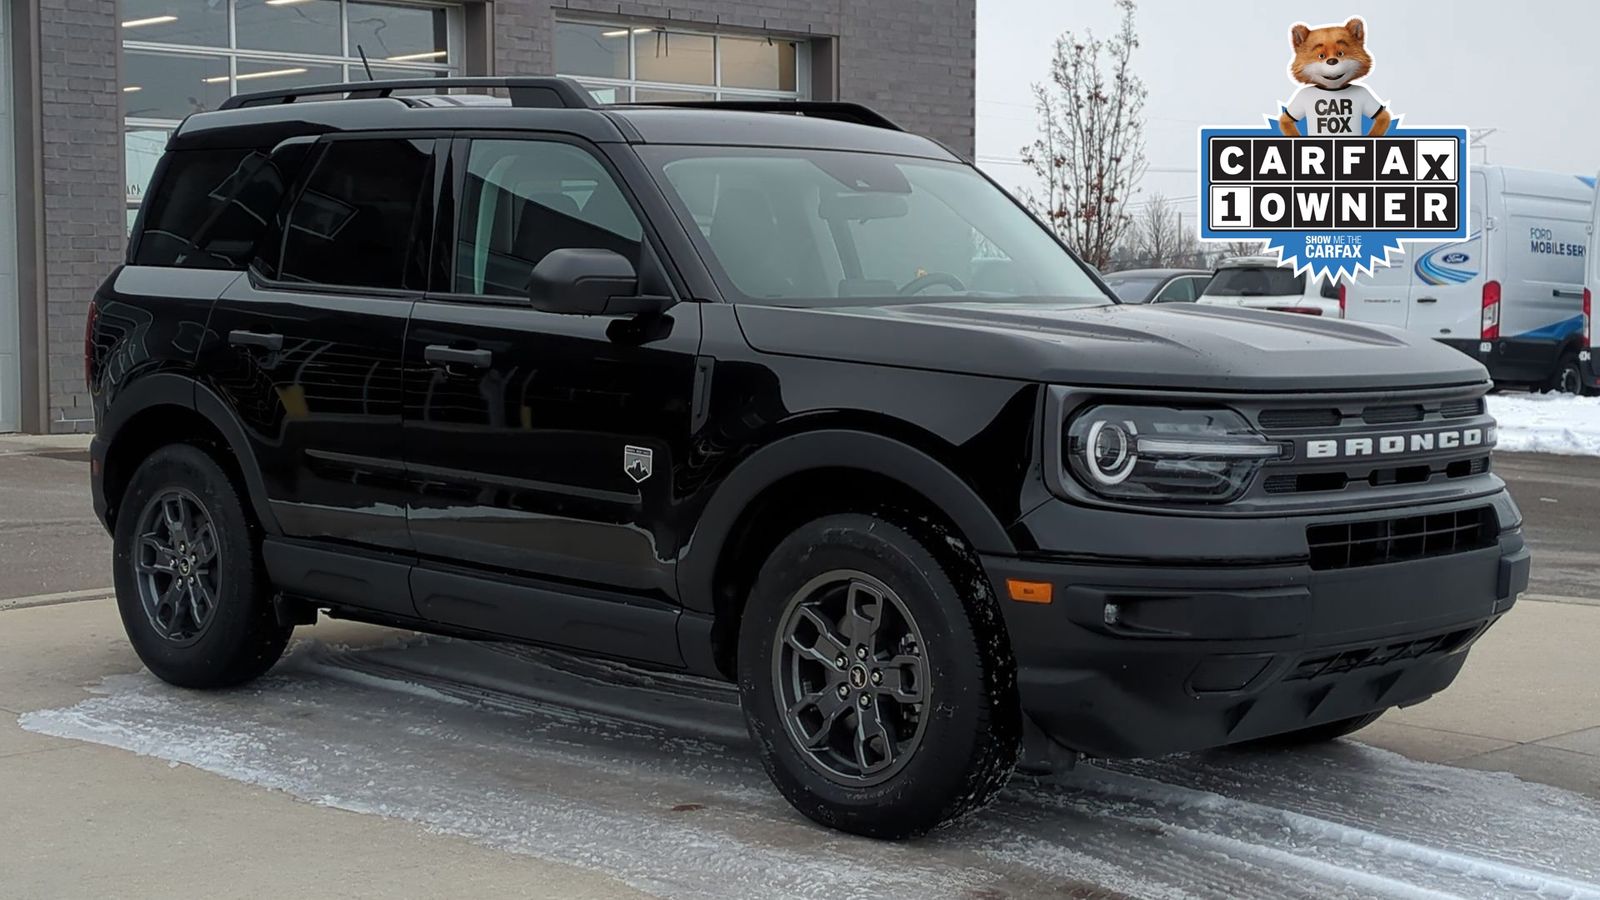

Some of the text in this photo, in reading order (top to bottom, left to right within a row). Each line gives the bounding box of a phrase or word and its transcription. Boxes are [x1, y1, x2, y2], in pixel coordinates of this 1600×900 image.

[1530, 227, 1553, 241] FORD
[1530, 240, 1565, 255] MOBILE
[1306, 428, 1482, 458] BRONCO
